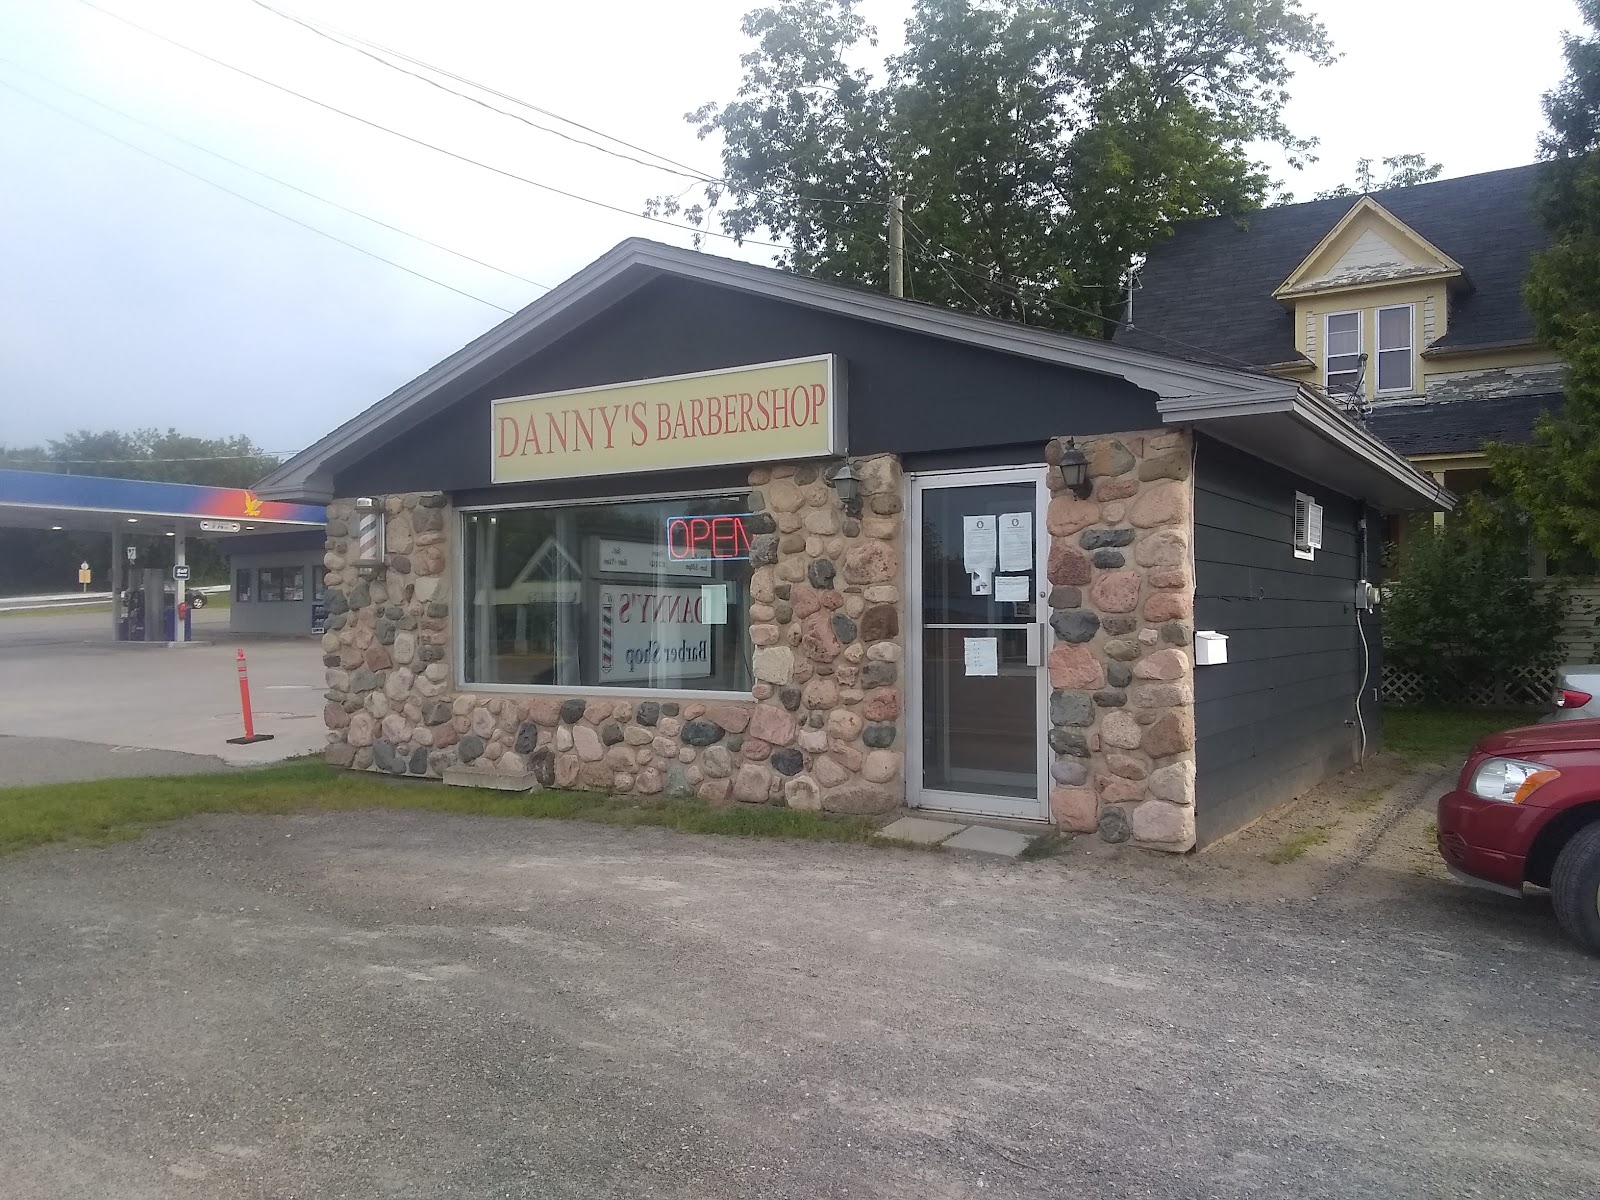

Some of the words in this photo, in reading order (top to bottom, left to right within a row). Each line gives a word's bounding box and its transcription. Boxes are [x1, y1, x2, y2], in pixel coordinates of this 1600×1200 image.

[498, 400, 649, 459] DANNY'S
[655, 383, 827, 442] BARBERSHOP
[669, 517, 755, 559] OPEN
